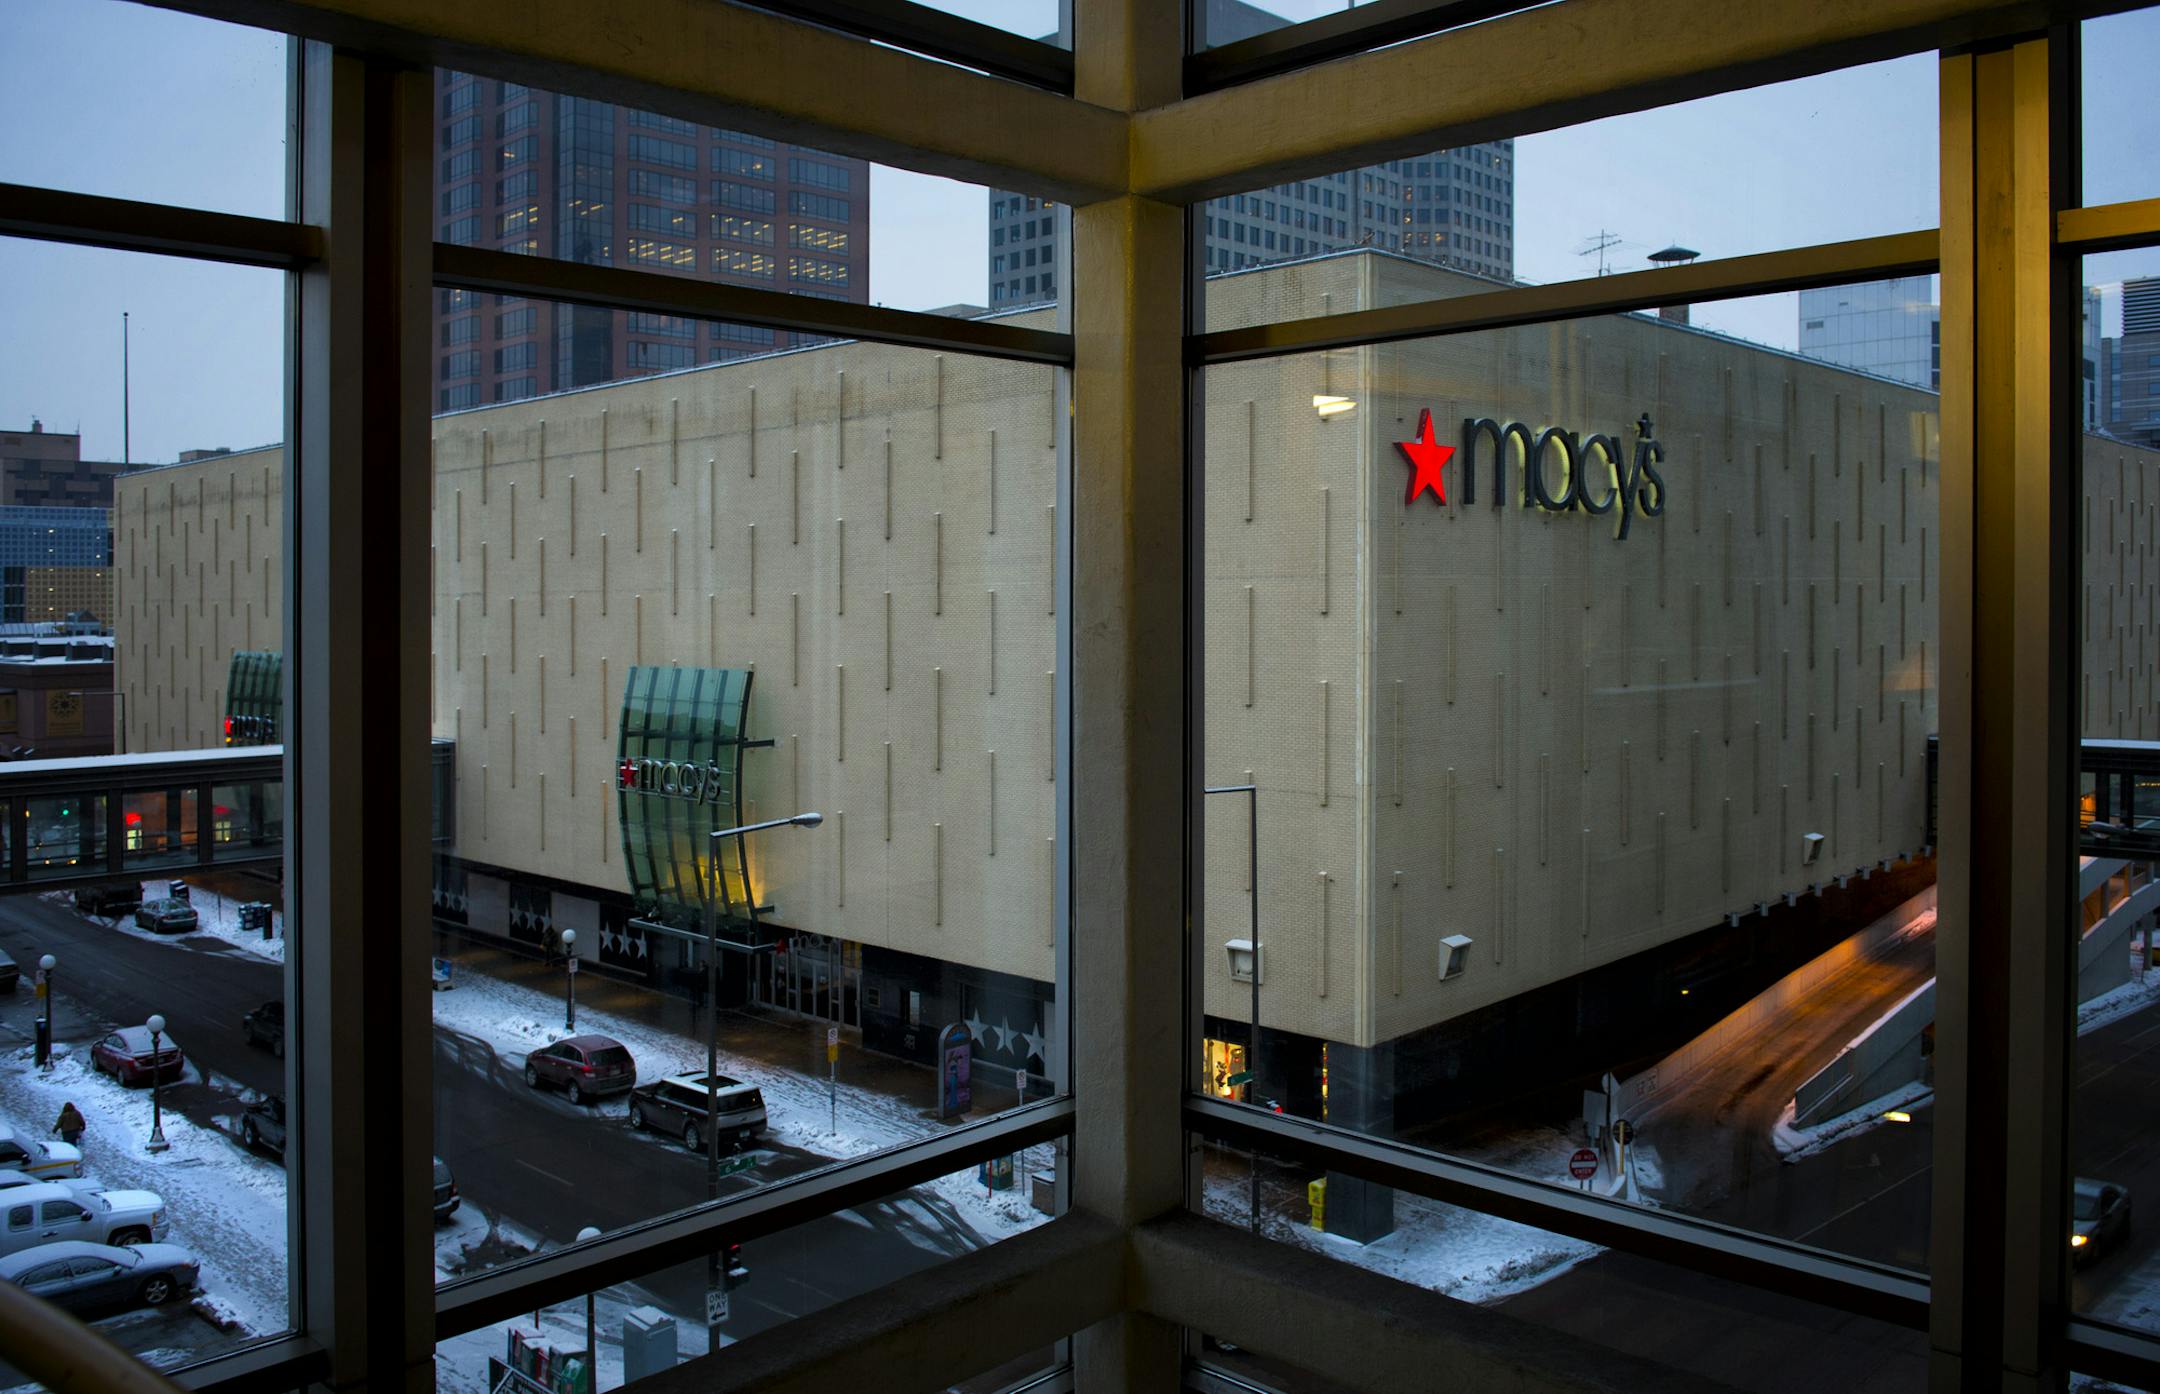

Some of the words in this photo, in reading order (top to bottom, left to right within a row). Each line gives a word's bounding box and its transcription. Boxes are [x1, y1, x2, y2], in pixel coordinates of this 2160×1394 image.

[1463, 413, 1665, 540] macy's
[638, 759, 721, 805] macy's
[709, 1291, 727, 1304] ONE
[709, 1302, 726, 1313] WAY
